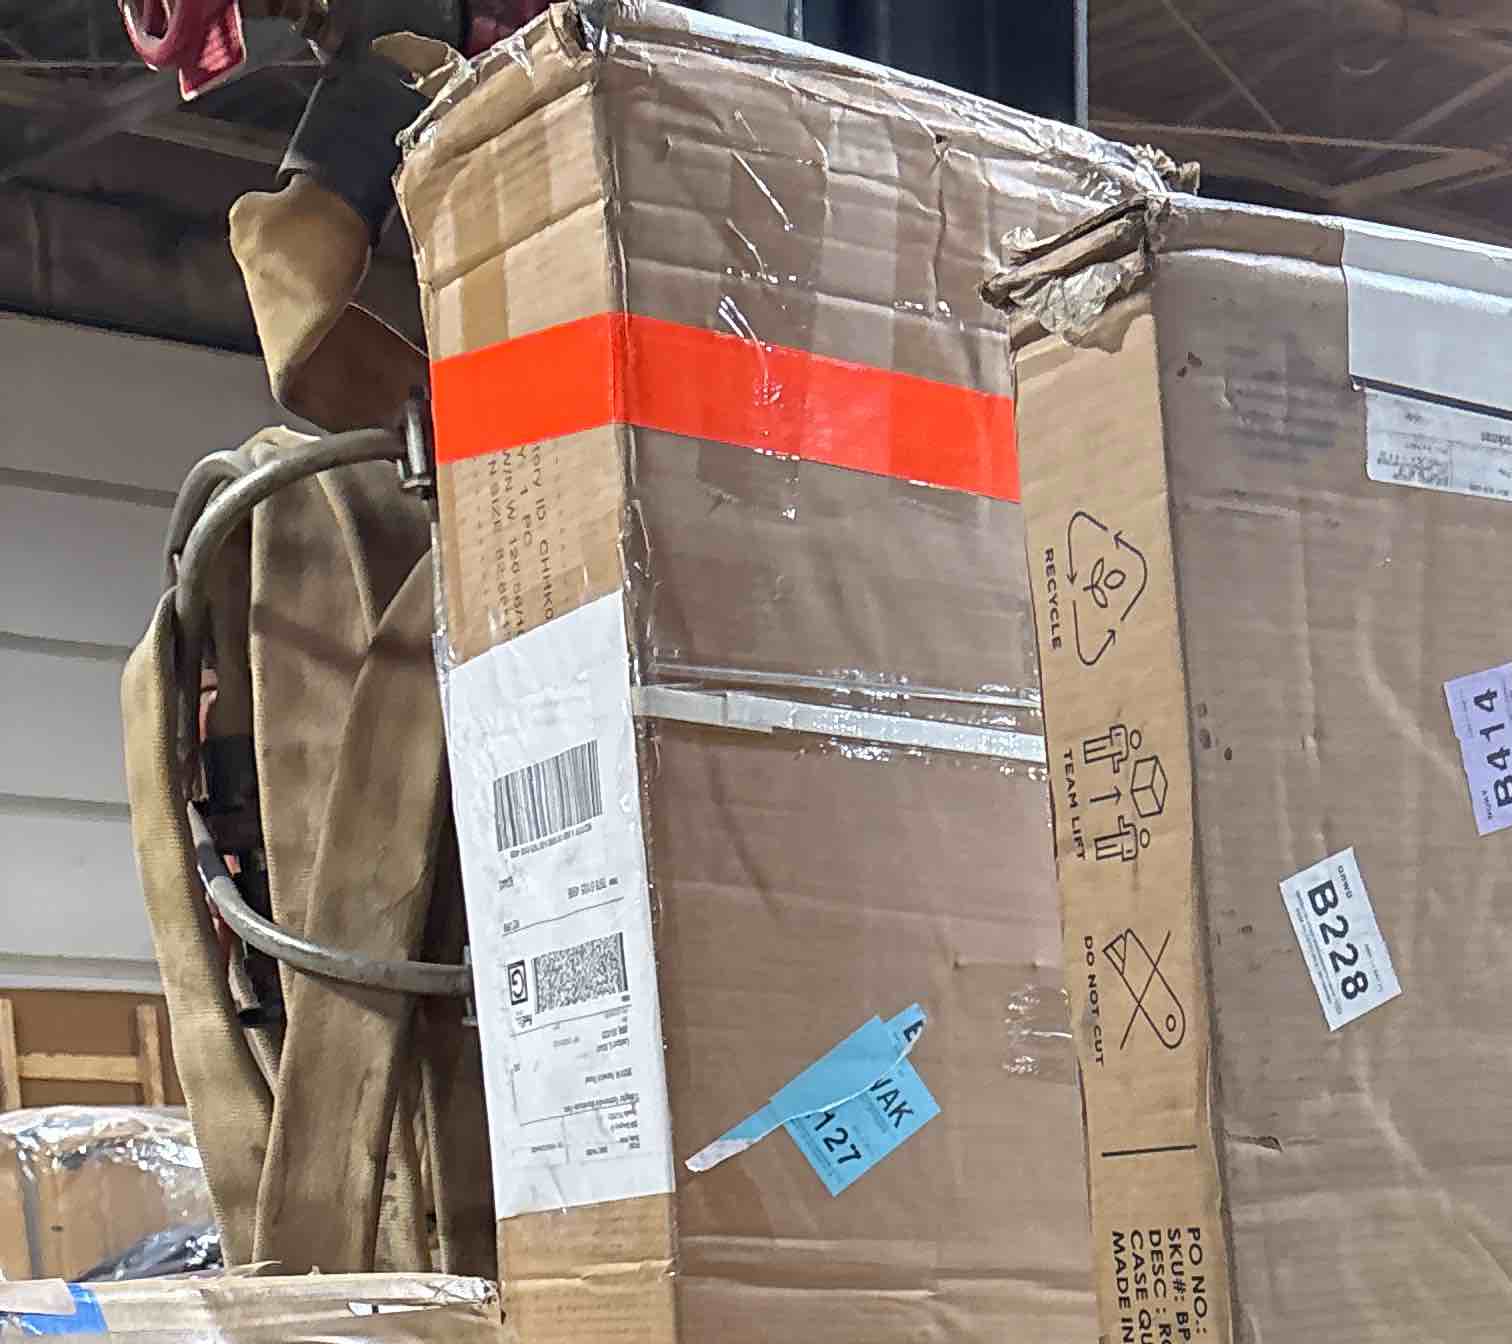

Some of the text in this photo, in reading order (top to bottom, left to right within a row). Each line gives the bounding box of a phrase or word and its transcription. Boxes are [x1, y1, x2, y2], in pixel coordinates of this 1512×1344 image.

[1044, 548, 1063, 651] RECYCLE
[1063, 748, 1086, 862] TEAM LIFT
[1308, 880, 1369, 1000] B228
[1084, 936, 1104, 1067] DO NOT CUT
[804, 1111, 862, 1164] 127
[1112, 1230, 1131, 1310] MADE
[1130, 1230, 1149, 1300] CASE
[1149, 1229, 1167, 1299] DESC
[1167, 1228, 1187, 1301] SKU#:
[1187, 1227, 1203, 1266] PO
[1121, 1317, 1134, 1343] IN
